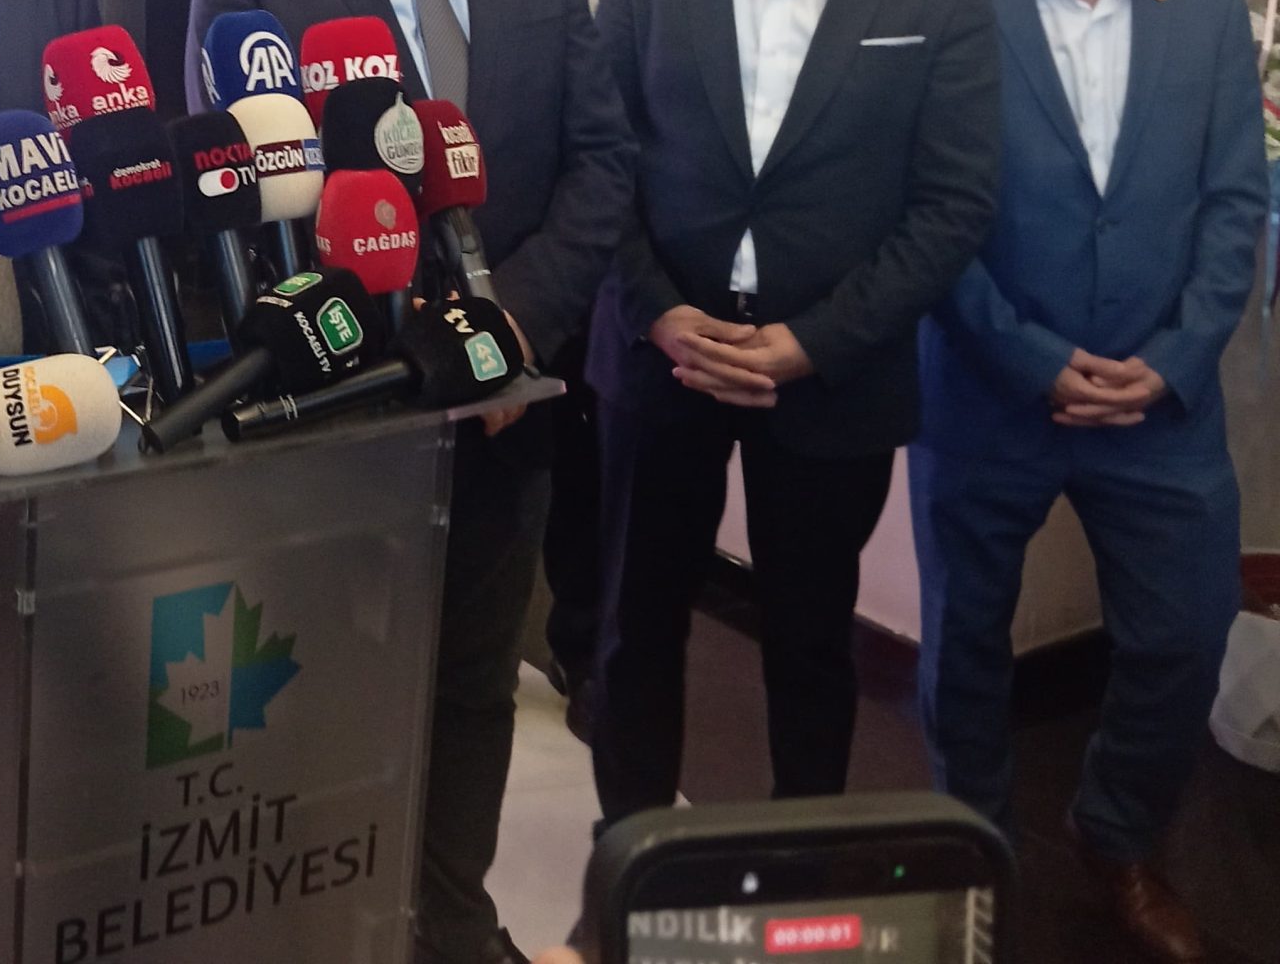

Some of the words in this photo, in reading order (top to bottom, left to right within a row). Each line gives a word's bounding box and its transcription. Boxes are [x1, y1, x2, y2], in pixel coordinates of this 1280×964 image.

[246, 46, 297, 92] AA
[343, 54, 400, 83] KOZ
[92, 83, 149, 111] anka
[238, 166, 257, 185] TV
[255, 144, 305, 172] ÖZGÜN
[352, 230, 417, 255] ÇAĞDAŞ
[326, 305, 354, 343] İŞTE
[443, 307, 475, 334] tv
[474, 341, 499, 373] 41
[2, 367, 33, 447] DUYSUN
[180, 680, 220, 706] 1923
[176, 763, 243, 807] T.C.
[140, 793, 298, 881] İZMİT
[55, 823, 378, 964] BELEDİYESİ
